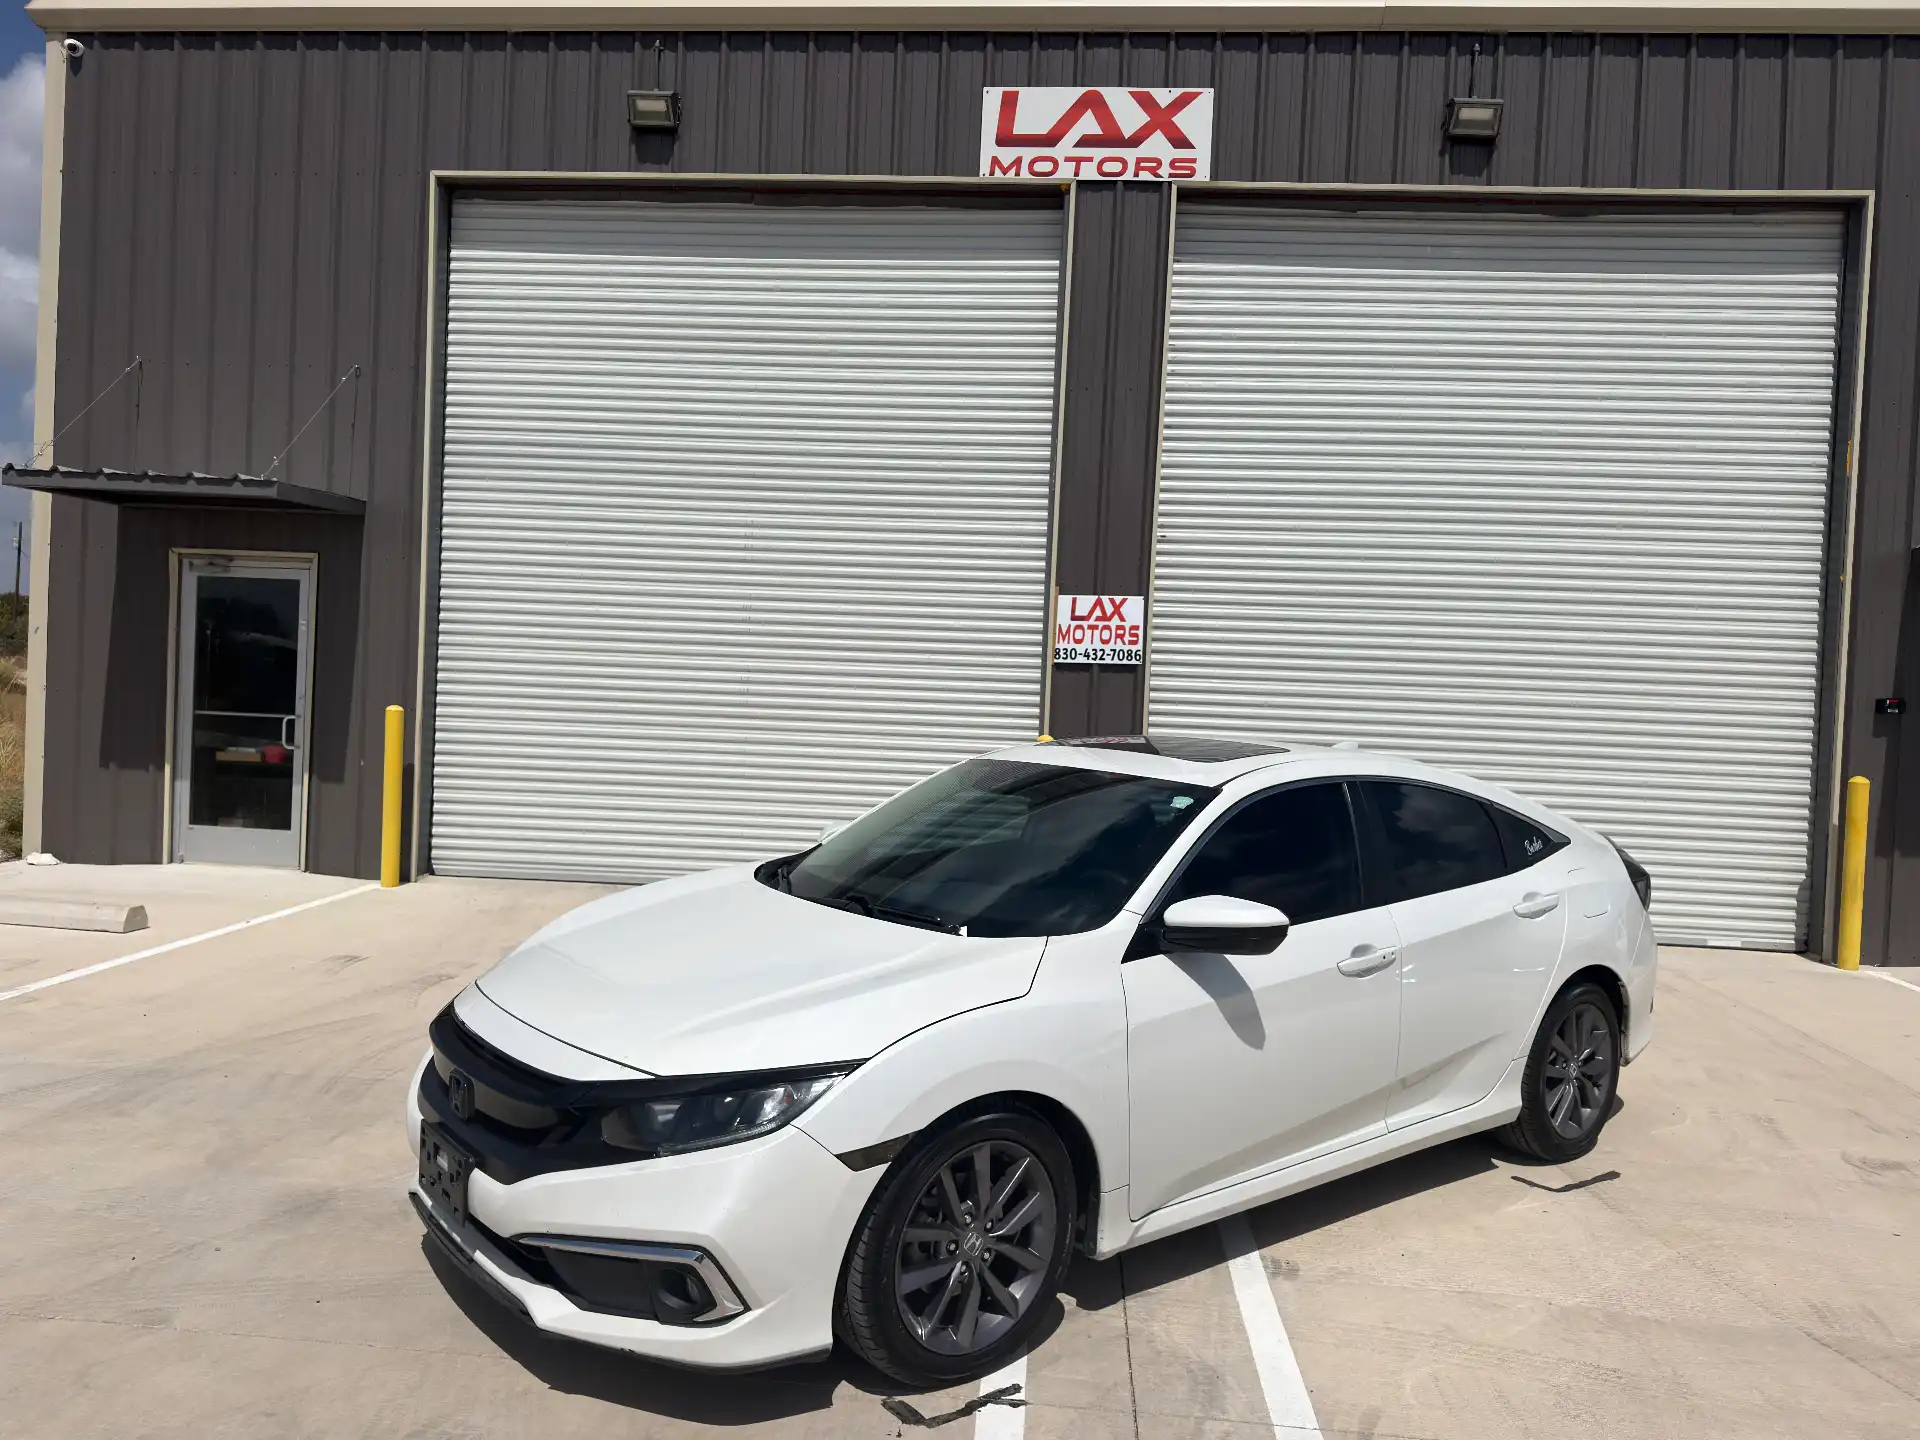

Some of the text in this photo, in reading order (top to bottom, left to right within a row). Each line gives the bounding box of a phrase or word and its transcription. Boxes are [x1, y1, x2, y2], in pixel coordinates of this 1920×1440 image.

[995, 89, 1203, 149] LAX
[988, 155, 1198, 179] MOTORS
[1070, 596, 1128, 622] LAX
[1057, 623, 1140, 646] MOTORS
[1054, 647, 1142, 662] 830-432-7086
